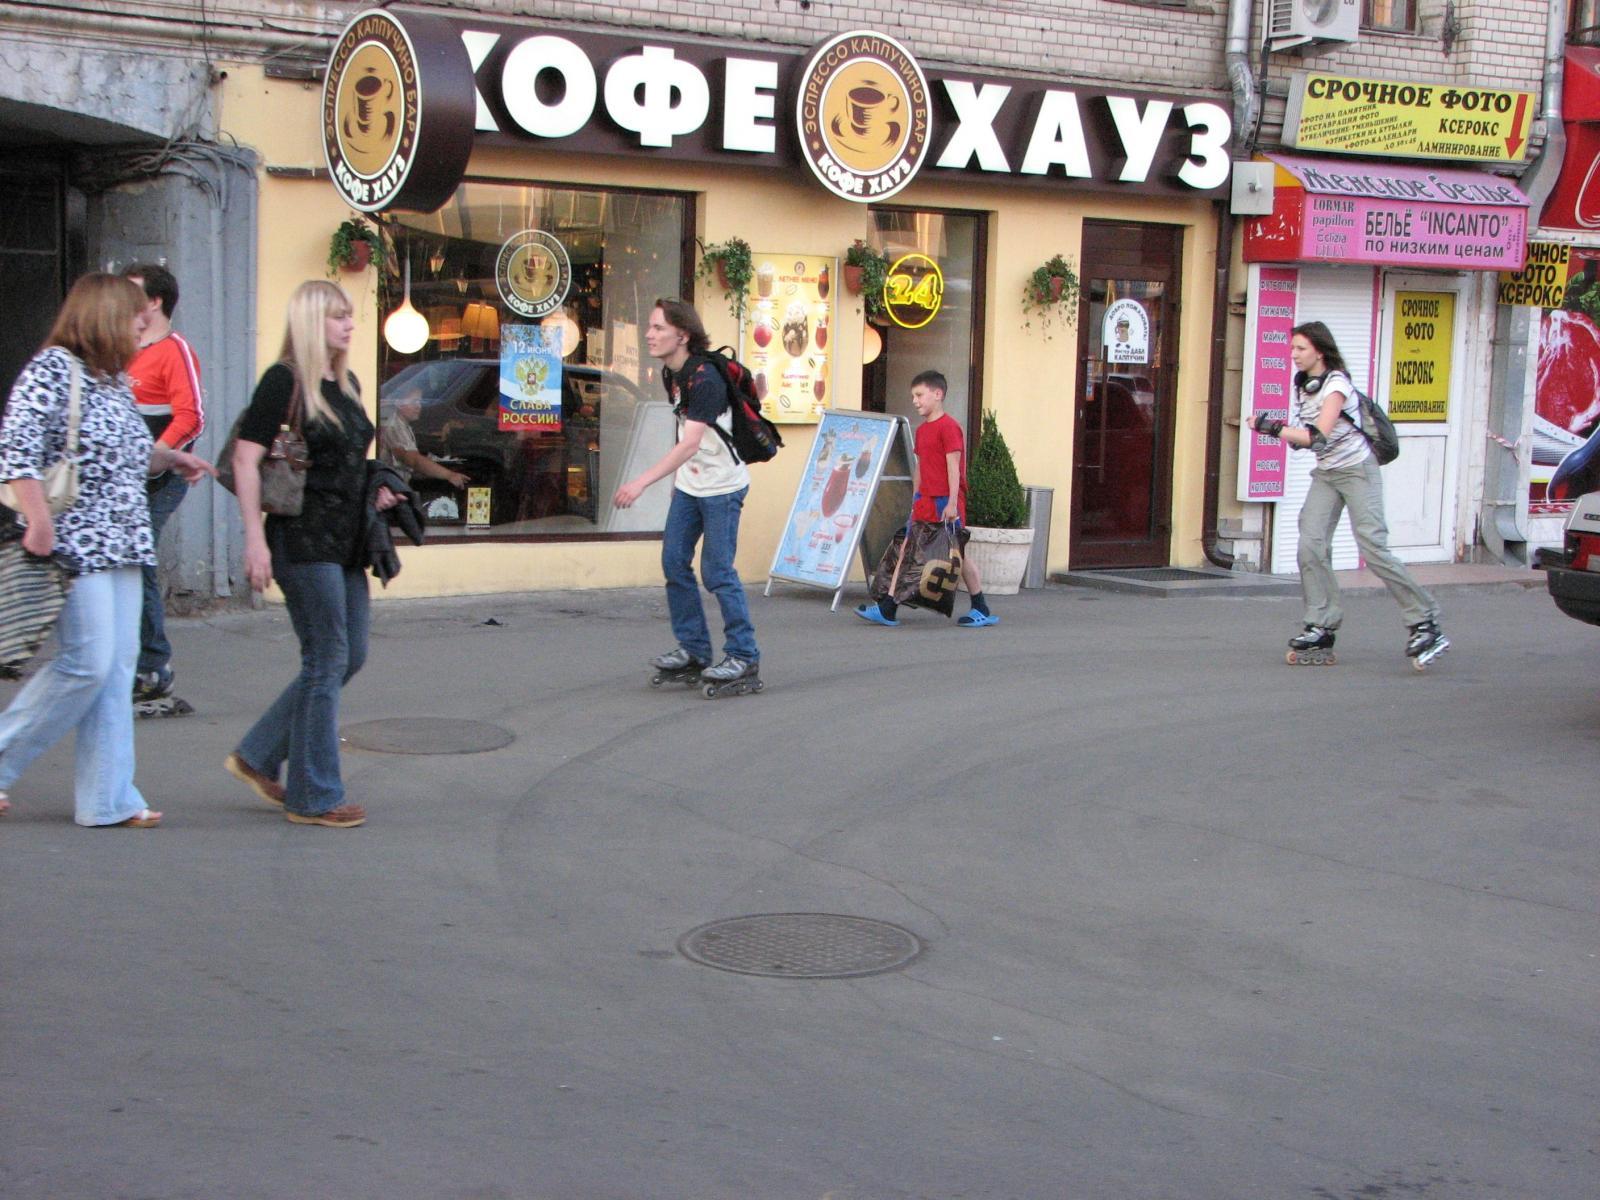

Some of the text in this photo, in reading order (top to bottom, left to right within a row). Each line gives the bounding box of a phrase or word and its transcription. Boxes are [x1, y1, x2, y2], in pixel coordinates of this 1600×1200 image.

[325, 18, 418, 140] ЭСПРЕССО КАППУЧИНО БАР
[804, 39, 926, 143] ЭСПРЕССО КАППУЧИНО БАР
[1307, 78, 1512, 113] СРОЧНОЕ ФОТО
[460, 30, 1231, 190] КОФЕ ХАУЗ
[1438, 118, 1500, 136] КСЕРОКС
[1416, 141, 1501, 157] ЛАМИНИРОВАНИЕ
[335, 154, 406, 202] КОФЕ ХАУЗ
[816, 153, 912, 195] КОФЕ ХАУЗ
[1300, 166, 1520, 203] Женское белье
[1313, 198, 1354, 213] LORMAR
[1312, 214, 1354, 228] papillon
[1365, 209, 1413, 237] БЕЛЬЁ
[1365, 239, 1504, 259] по низким ценам
[889, 273, 938, 310] 24
[1497, 282, 1563, 307] КСЕРОКС
[507, 293, 561, 313] КОФЕ ХАУЗ
[1401, 299, 1440, 318] СРОЧНОЕ
[1404, 322, 1435, 341] ФОТО
[512, 340, 526, 354] 12
[1395, 361, 1435, 385] КСЕРОКС
[510, 400, 553, 411] СЛАВА
[1388, 400, 1445, 414] ЛАМИНИРОВАНИЕ
[502, 412, 560, 425] РОССИИ!
